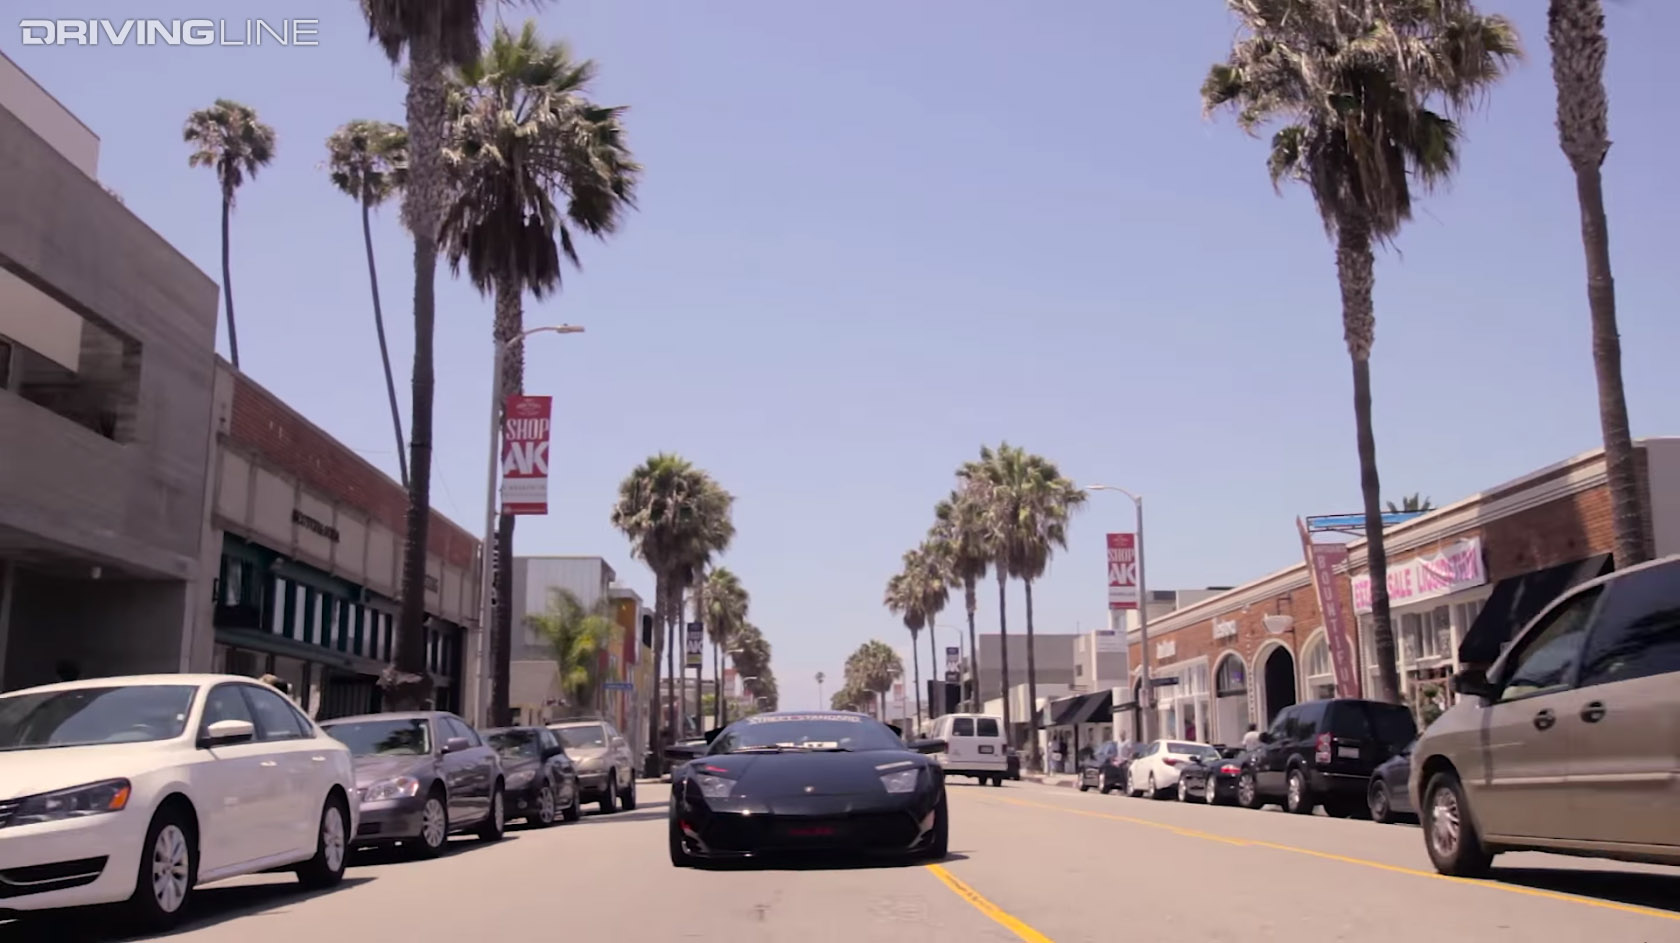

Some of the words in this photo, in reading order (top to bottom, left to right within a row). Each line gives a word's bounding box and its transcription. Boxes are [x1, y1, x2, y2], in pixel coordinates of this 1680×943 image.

[505, 418, 549, 441] SHOP
[503, 441, 549, 475] AK
[1109, 563, 1136, 584] AK
